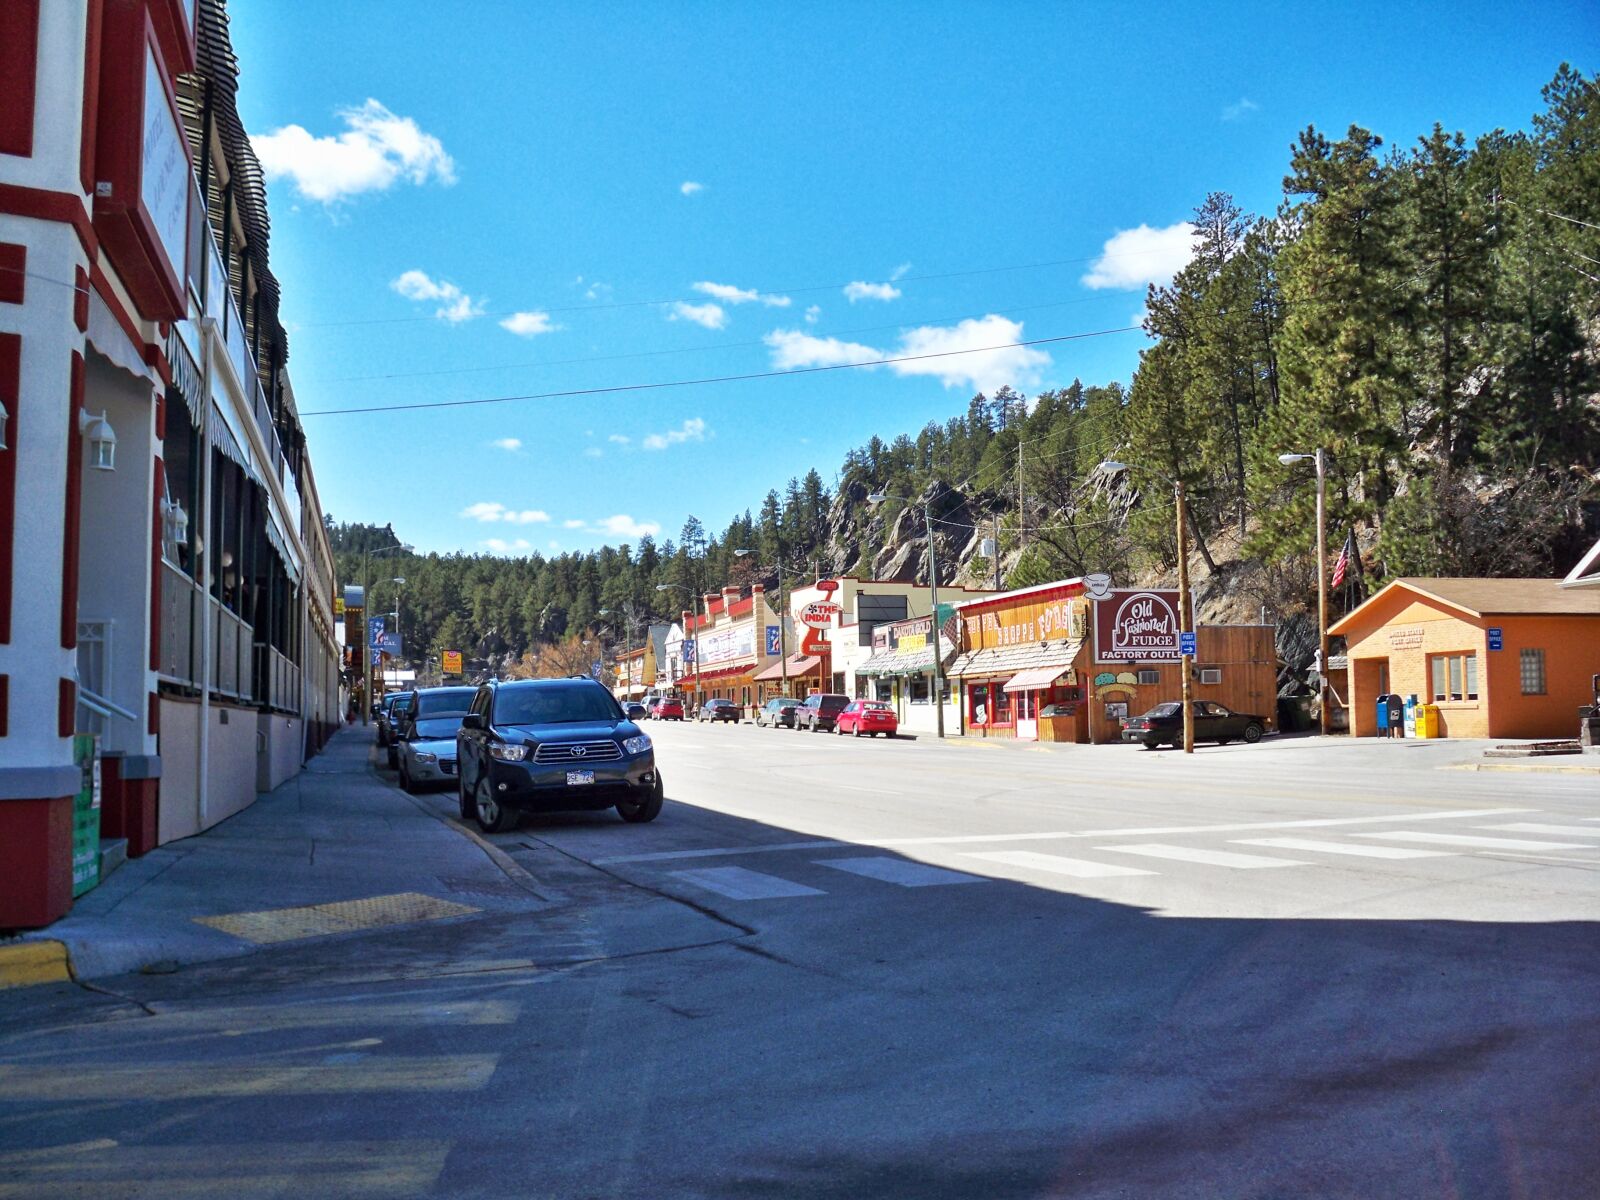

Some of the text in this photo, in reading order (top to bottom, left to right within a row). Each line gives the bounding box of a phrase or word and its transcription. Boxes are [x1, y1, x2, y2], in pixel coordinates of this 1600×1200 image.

[1131, 599, 1153, 619] Old
[893, 620, 931, 639] DAKOTA GOLD
[1132, 635, 1173, 646] FUDGE
[1102, 651, 1183, 659] FACTORY OUTLE
